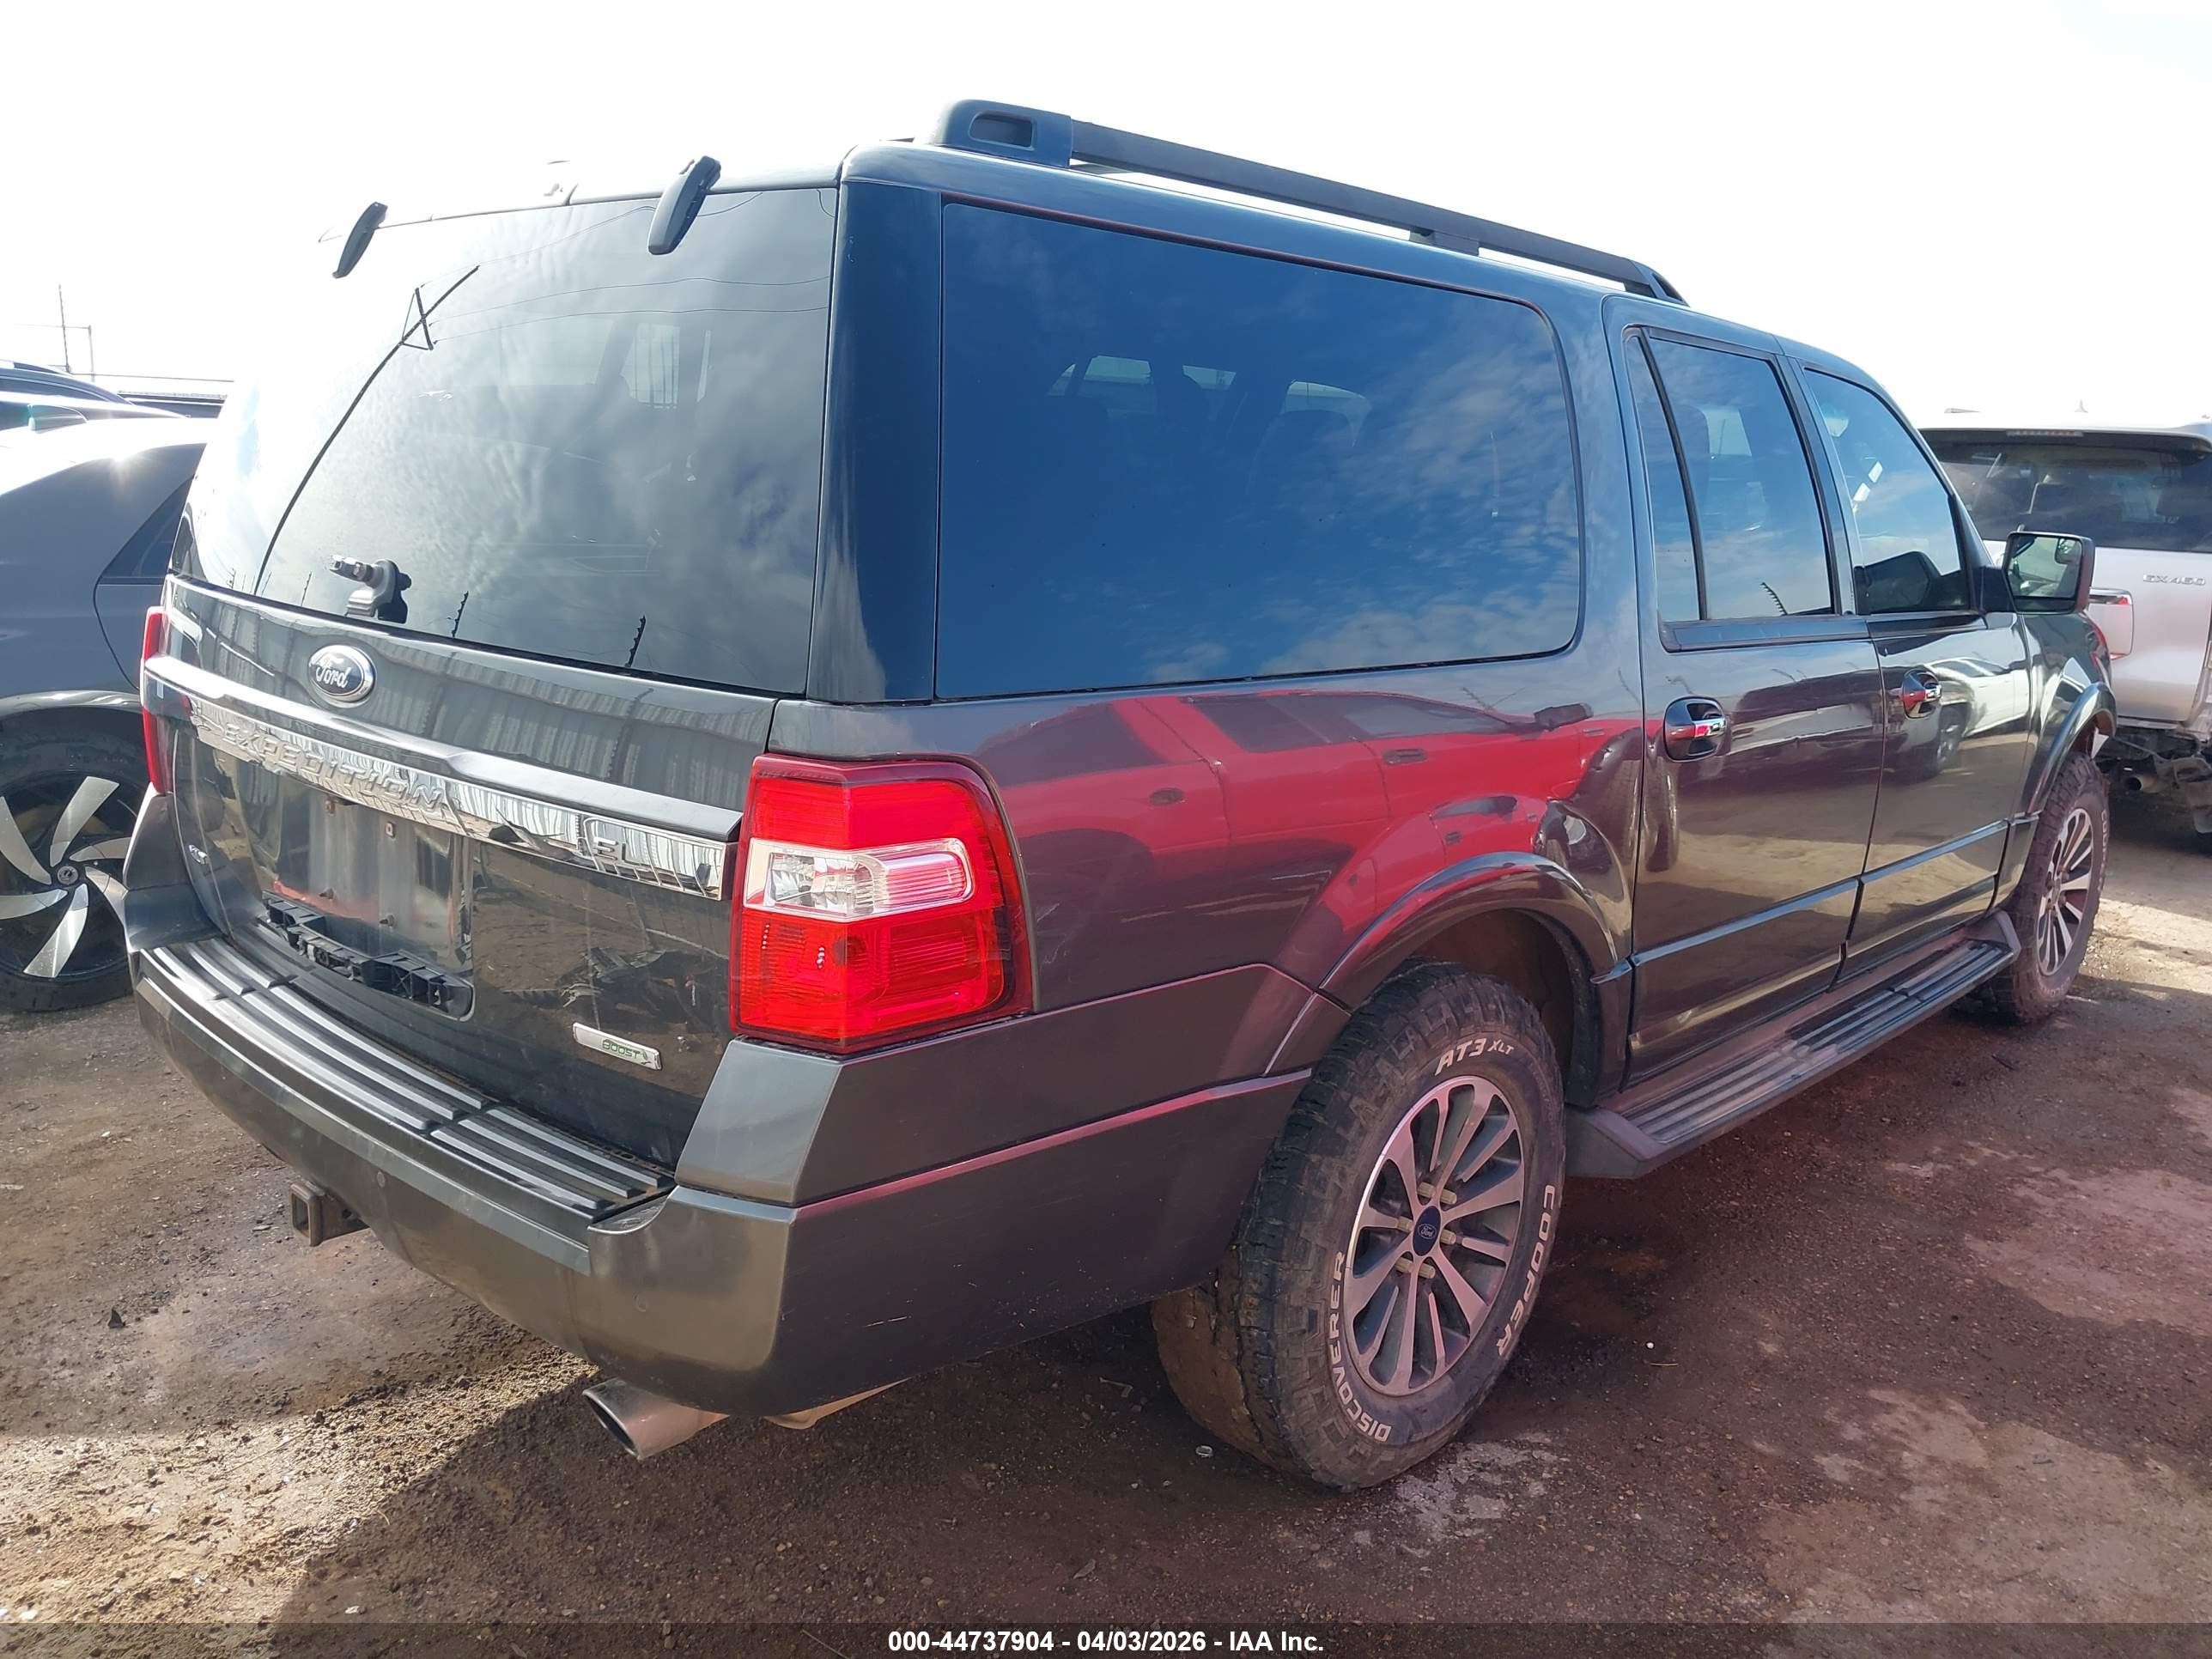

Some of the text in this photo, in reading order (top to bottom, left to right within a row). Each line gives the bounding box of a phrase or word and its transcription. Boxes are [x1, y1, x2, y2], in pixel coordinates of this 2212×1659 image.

[314, 657, 352, 689] Ford
[221, 722, 446, 810] EXPEDITION
[592, 836, 642, 866] EL
[1434, 1037, 1514, 1077] AT3 XLT
[1496, 1184, 1556, 1356] COOPER
[1328, 1250, 1393, 1443] DISCOVERER
